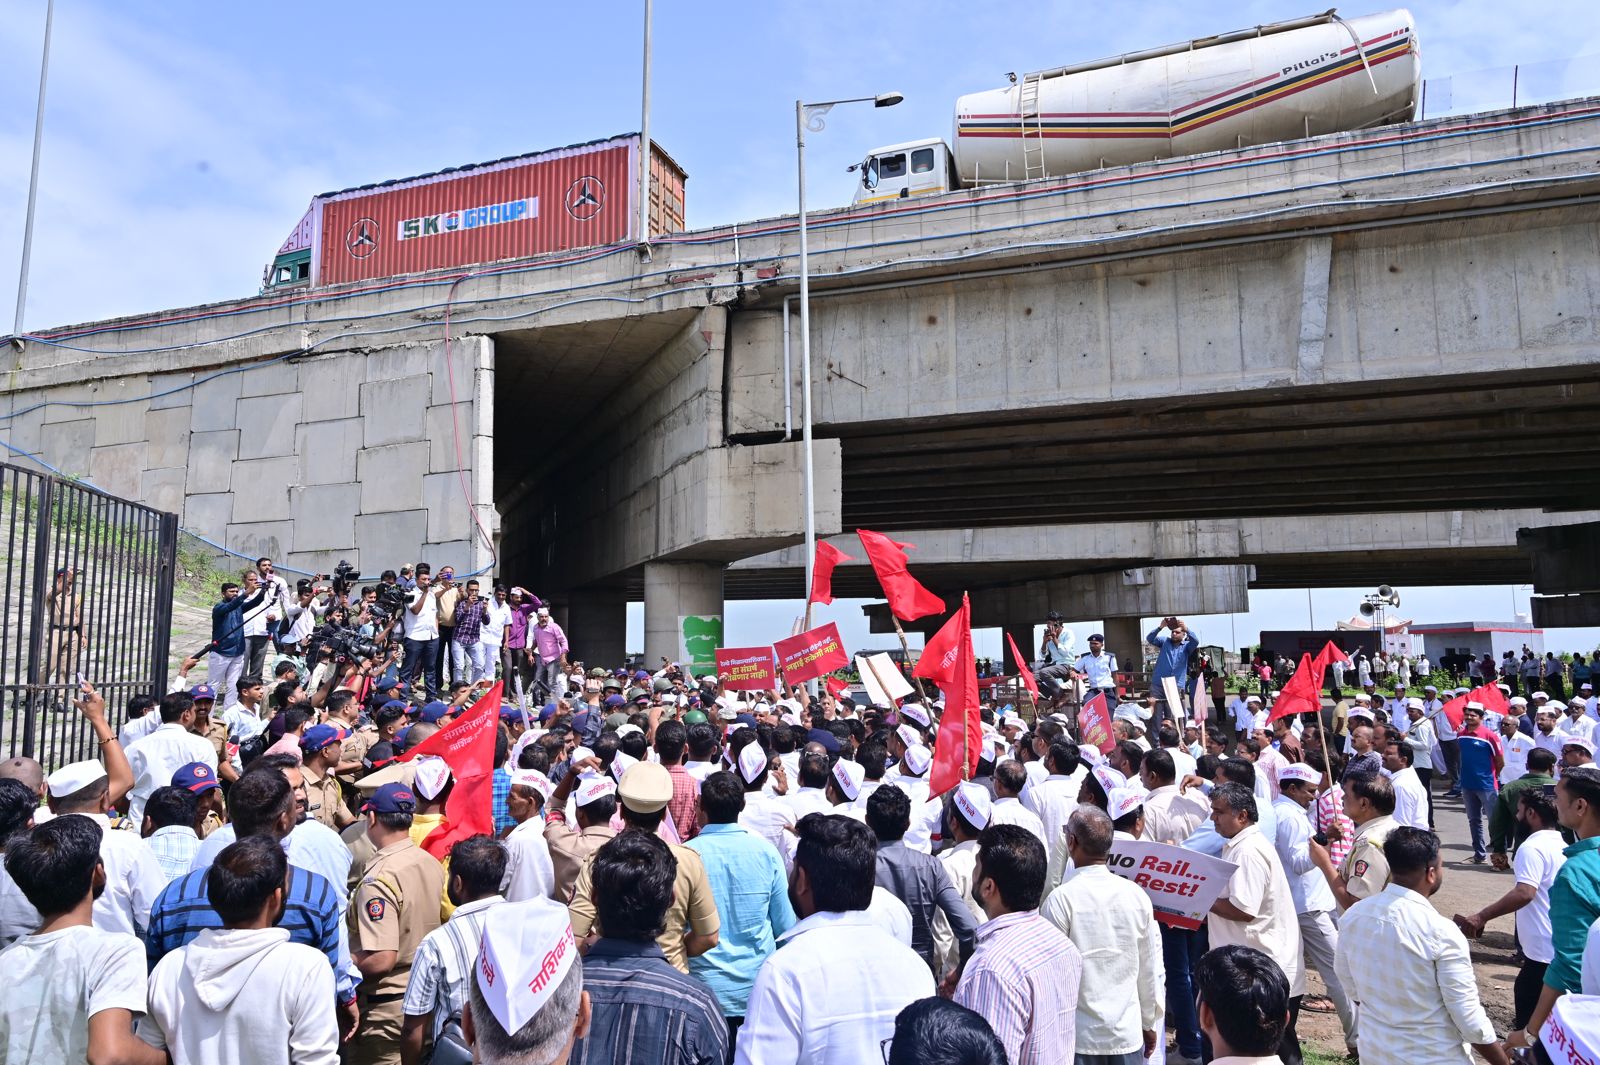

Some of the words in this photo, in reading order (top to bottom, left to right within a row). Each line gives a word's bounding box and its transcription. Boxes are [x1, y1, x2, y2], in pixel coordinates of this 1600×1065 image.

[1282, 52, 1338, 75] Pillai's
[464, 200, 527, 228] GROUP
[1107, 853, 1136, 868] No
[1140, 855, 1207, 881] Rail...
[1134, 872, 1200, 898] Rest!
